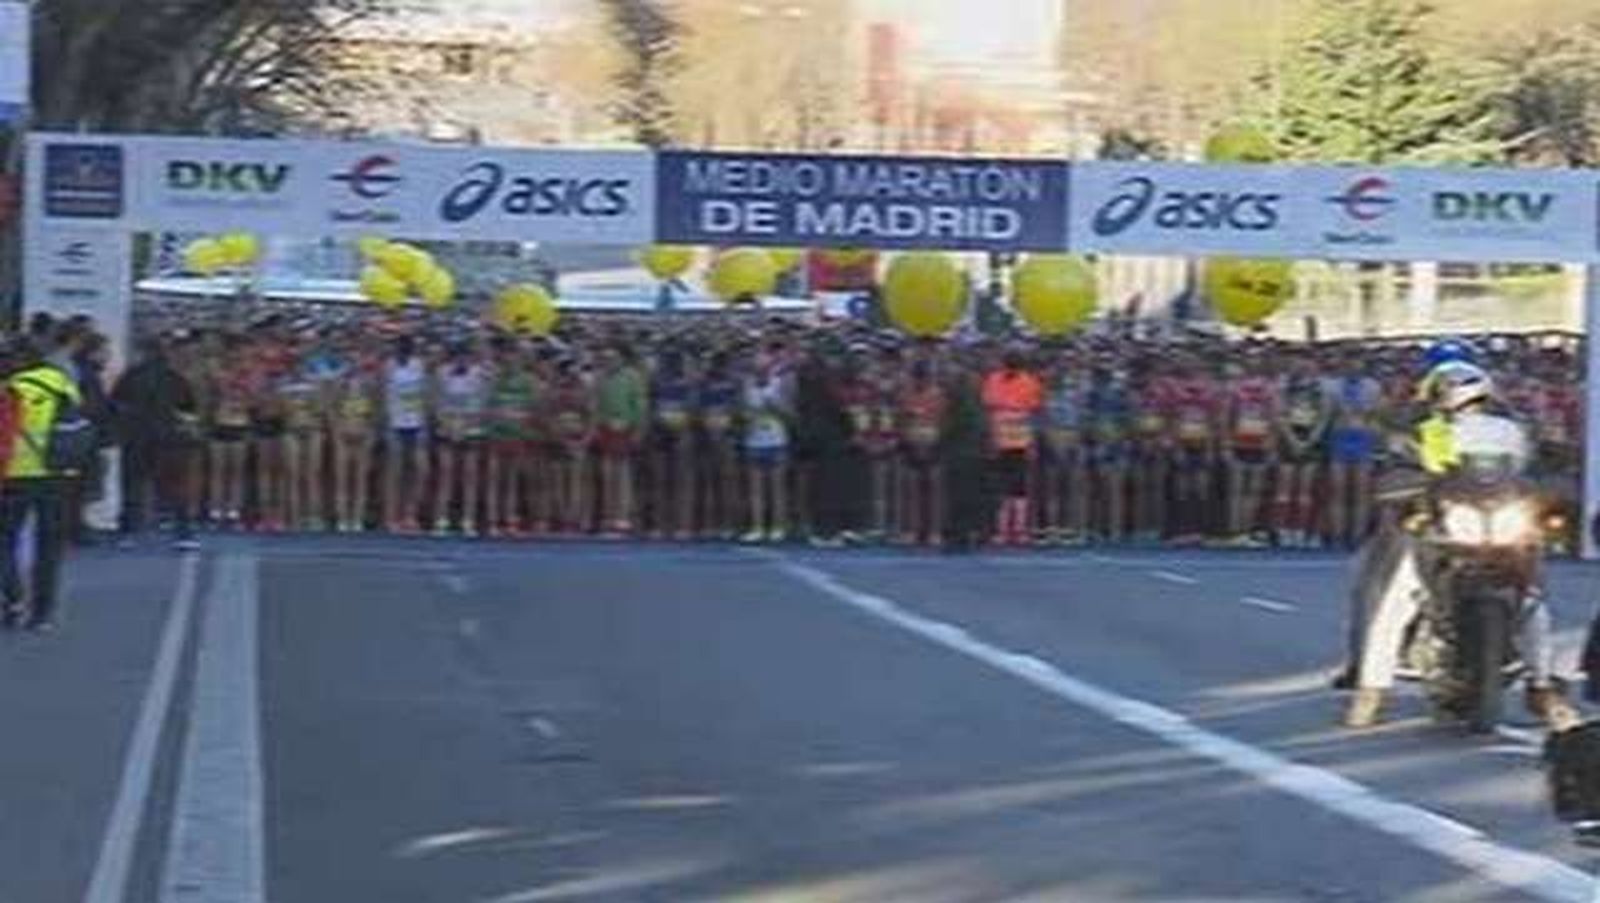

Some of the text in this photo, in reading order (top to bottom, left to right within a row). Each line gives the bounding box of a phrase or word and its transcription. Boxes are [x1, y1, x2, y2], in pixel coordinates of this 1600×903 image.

[166, 161, 291, 193] DKV
[684, 159, 824, 196] MEDIO
[502, 177, 631, 217] asics
[1153, 191, 1281, 231] asics
[1432, 191, 1554, 223] DKV
[702, 202, 1022, 240] DE MADRID
